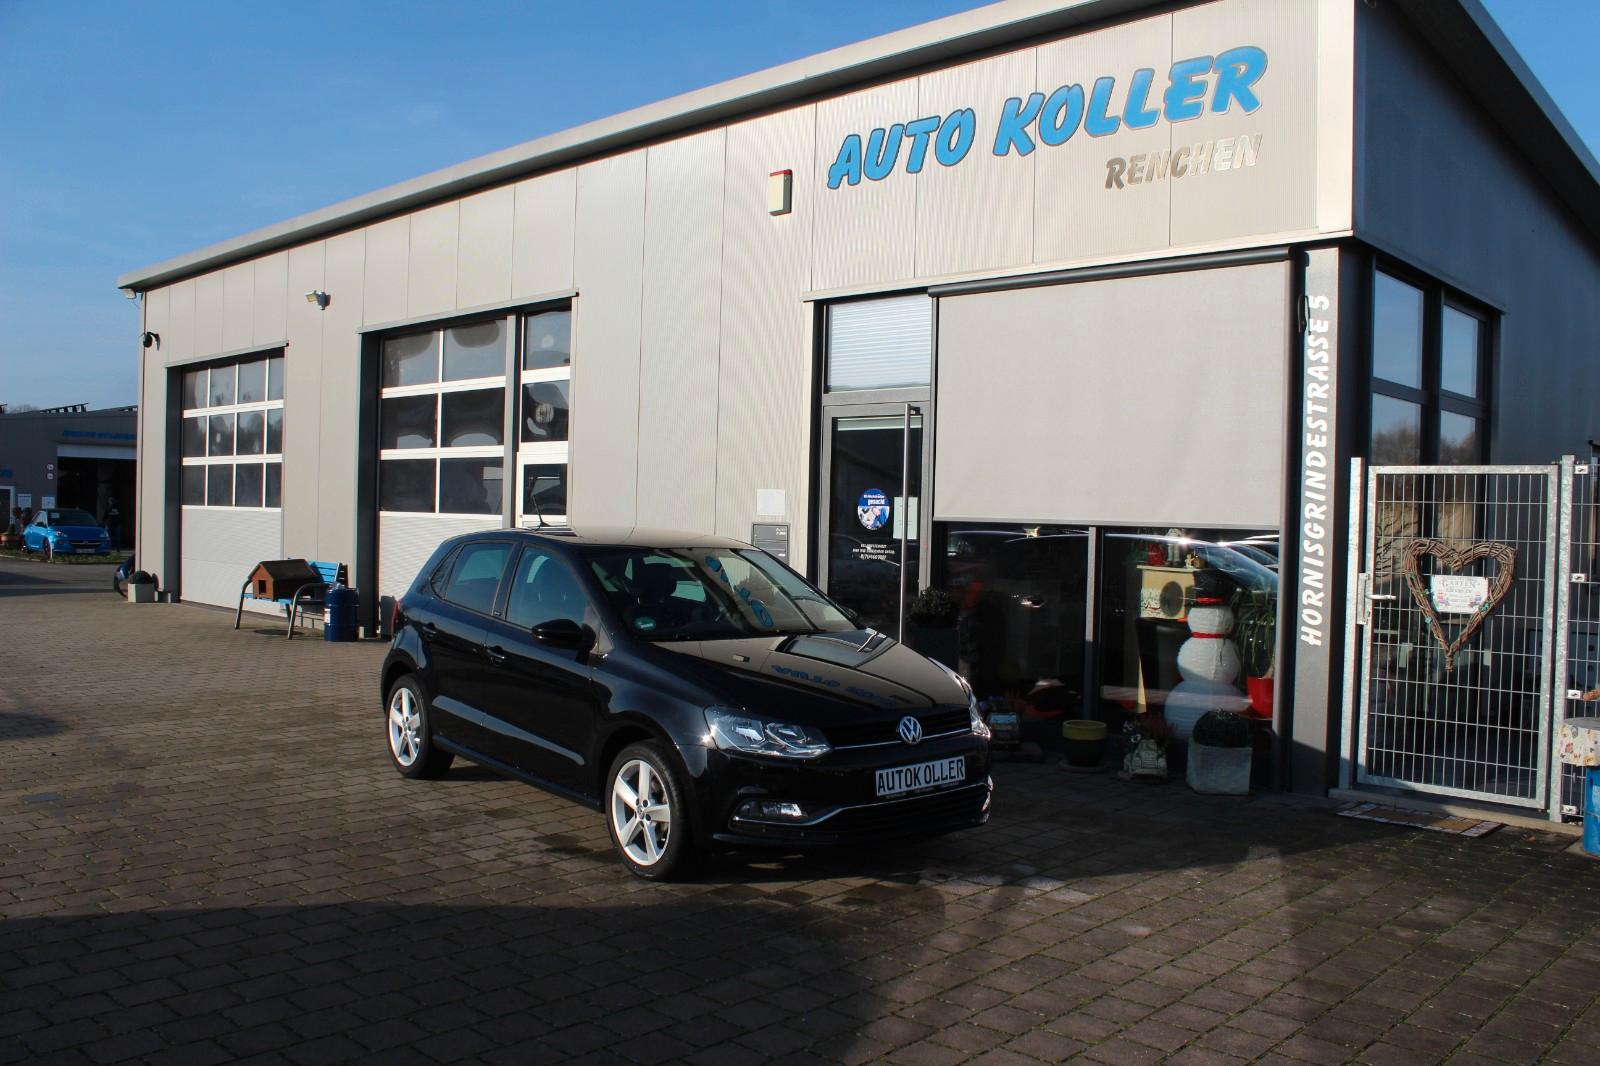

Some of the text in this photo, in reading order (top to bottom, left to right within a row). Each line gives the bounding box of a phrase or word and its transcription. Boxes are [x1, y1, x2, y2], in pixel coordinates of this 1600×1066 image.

[827, 45, 1268, 190] AUTO KOLLER
[1105, 133, 1263, 190] RENCHEN
[1301, 295, 1329, 646] HORNISGRINDESTRASSE 5
